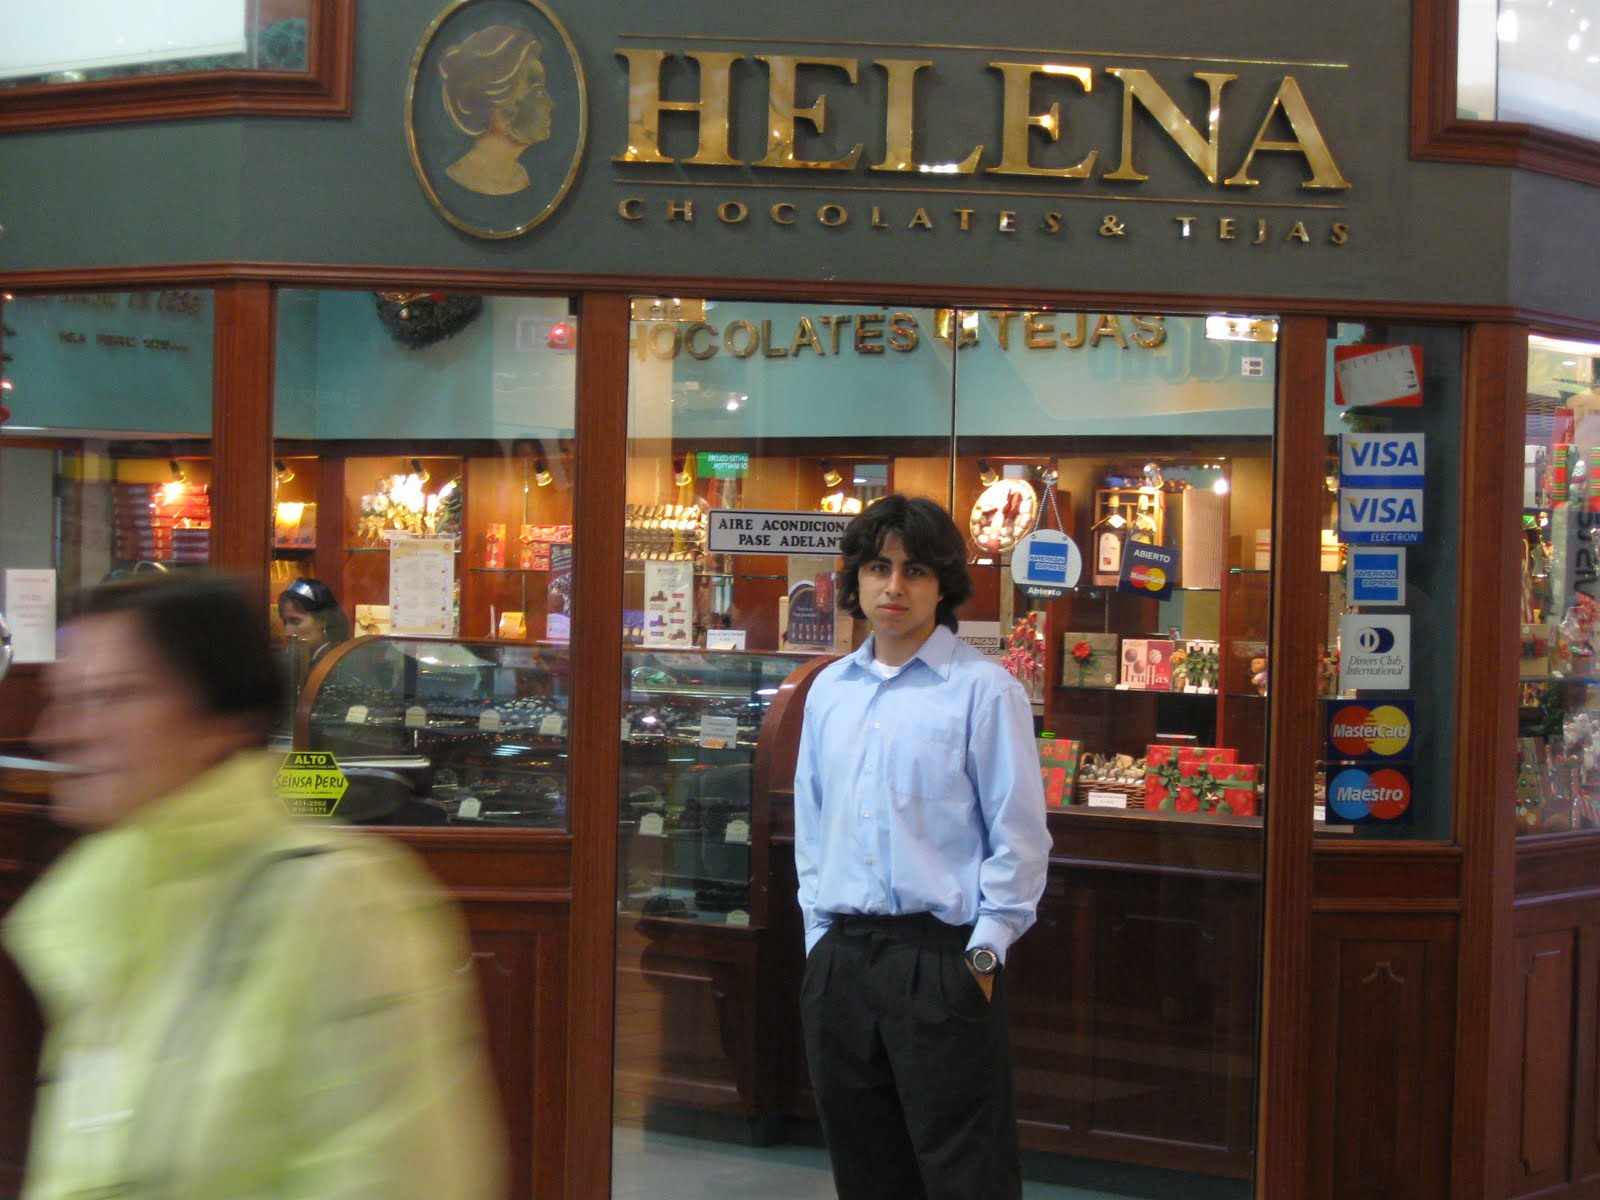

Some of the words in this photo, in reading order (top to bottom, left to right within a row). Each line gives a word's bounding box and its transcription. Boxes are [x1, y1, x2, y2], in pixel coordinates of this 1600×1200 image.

[611, 49, 1352, 189] HELENA
[617, 198, 1063, 235] CHOCOLATES
[1100, 215, 1126, 237] &
[1174, 216, 1350, 246] TEJAS
[630, 311, 919, 362] HOCOLATES
[988, 309, 1167, 350] TEJAS
[1347, 442, 1418, 467] VISA
[1346, 498, 1417, 523] VISA
[718, 518, 753, 531] AIRE
[762, 519, 845, 533] ACONDICION
[738, 534, 771, 546] PASE
[779, 535, 843, 548] ADELAN
[1370, 533, 1418, 542] ELECTRON
[1029, 555, 1066, 563] AMERICAN
[1133, 549, 1171, 563] ABIERTO
[1034, 563, 1067, 571] EXPRESS
[1353, 570, 1397, 578] AMERICAN
[1130, 571, 1167, 585] MasterCard
[1361, 579, 1399, 588] EXPRESS
[1027, 587, 1061, 597] Abierto
[1349, 655, 1378, 666] Diners
[1380, 655, 1401, 665] Club
[1346, 665, 1404, 675] International
[1333, 723, 1409, 738] MasterCard
[294, 755, 327, 765] ALTO
[315, 774, 345, 790] PERU
[1336, 786, 1404, 802] Maestro
